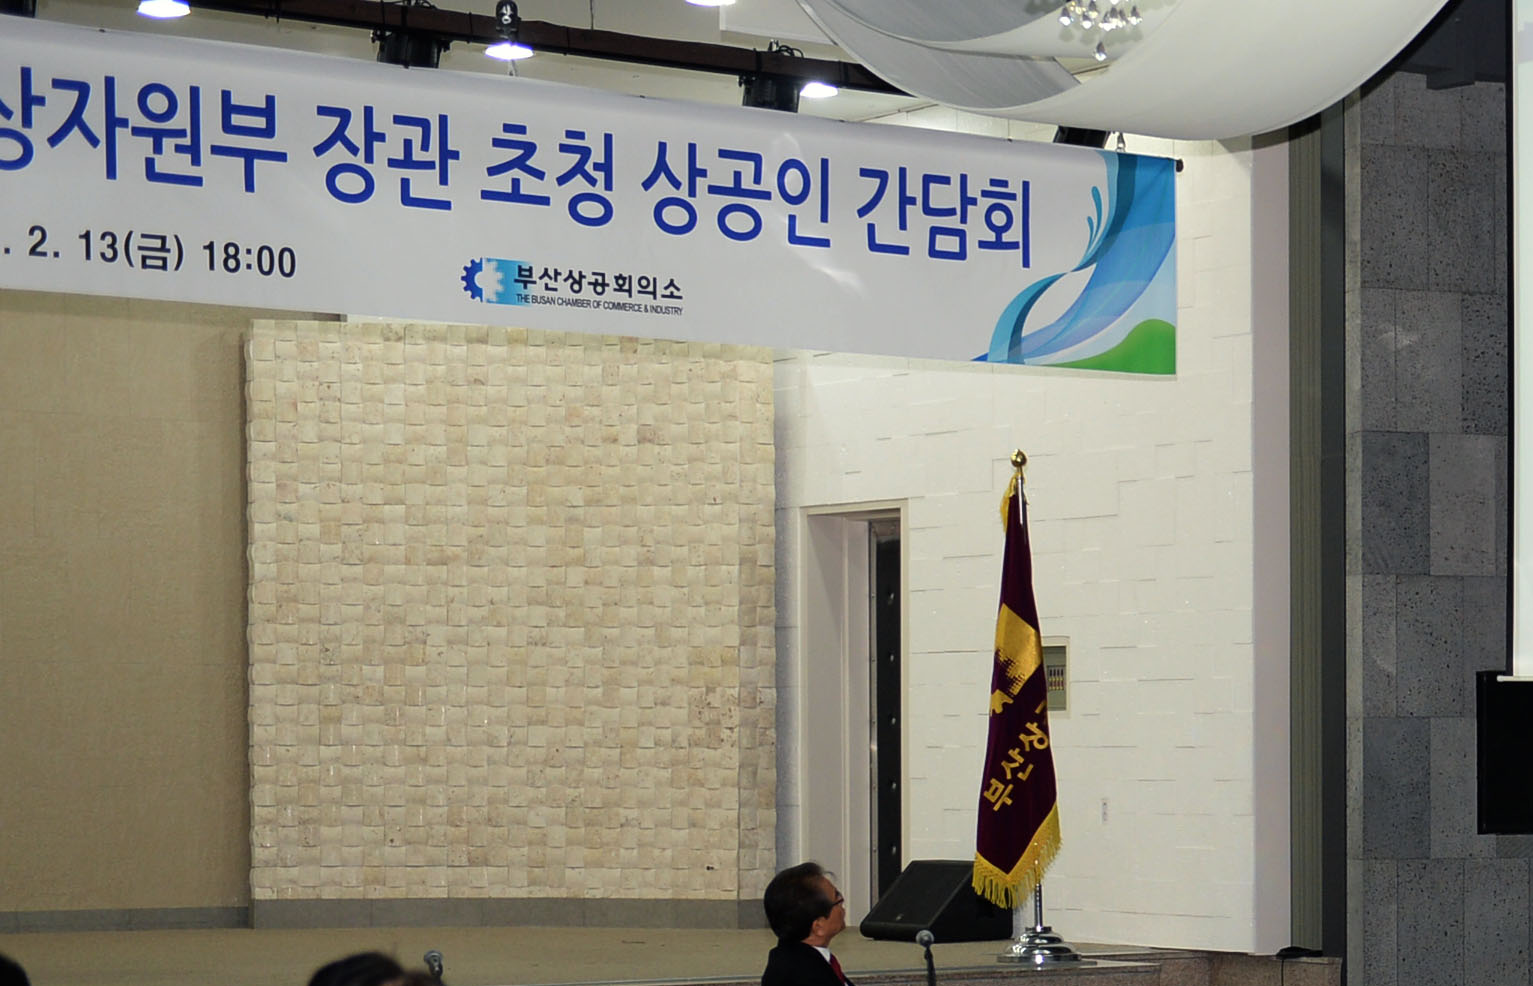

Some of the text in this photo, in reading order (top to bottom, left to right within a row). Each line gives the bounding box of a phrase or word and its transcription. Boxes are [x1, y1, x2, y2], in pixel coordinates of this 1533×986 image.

[313, 104, 460, 211] 장관
[480, 123, 614, 227] 초청
[641, 141, 833, 248] 상공인
[857, 166, 1031, 268] 간담회
[28, 224, 297, 278] 2. 13(금) 18:00
[514, 264, 683, 300] 부산상공회의소
[517, 293, 530, 303] THE
[531, 294, 556, 305] BUSAN
[557, 296, 592, 308] CHAMBER
[593, 301, 602, 309] OF
[603, 301, 643, 313] COMMERCE
[650, 304, 683, 316] INDUSTRY
